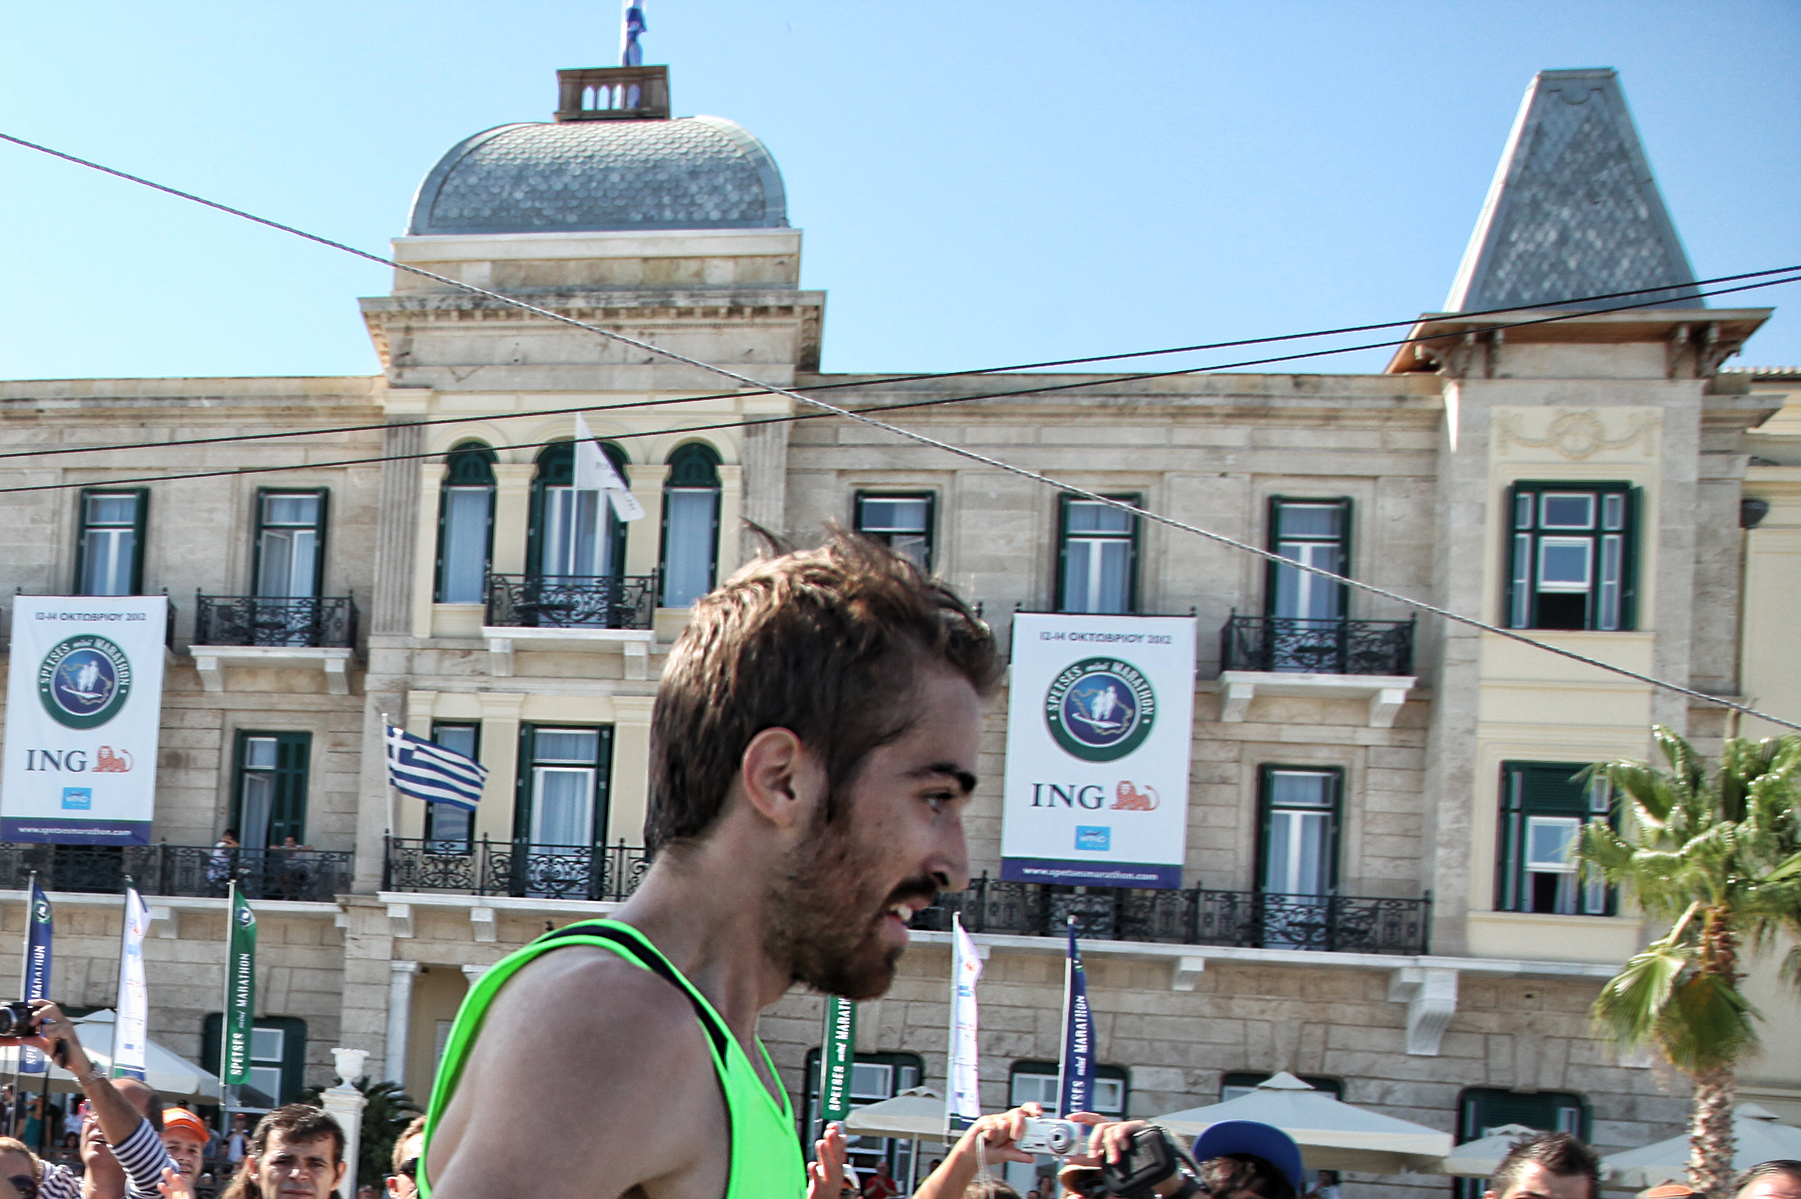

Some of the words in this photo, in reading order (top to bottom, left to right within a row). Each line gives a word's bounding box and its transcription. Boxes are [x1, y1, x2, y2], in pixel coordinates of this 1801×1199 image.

[1111, 661, 1154, 715] MARATHON
[25, 749, 88, 773] ING
[1031, 783, 1105, 810] ING
[235, 953, 250, 1008] MARATHON
[230, 1032, 245, 1076] SPETSES
